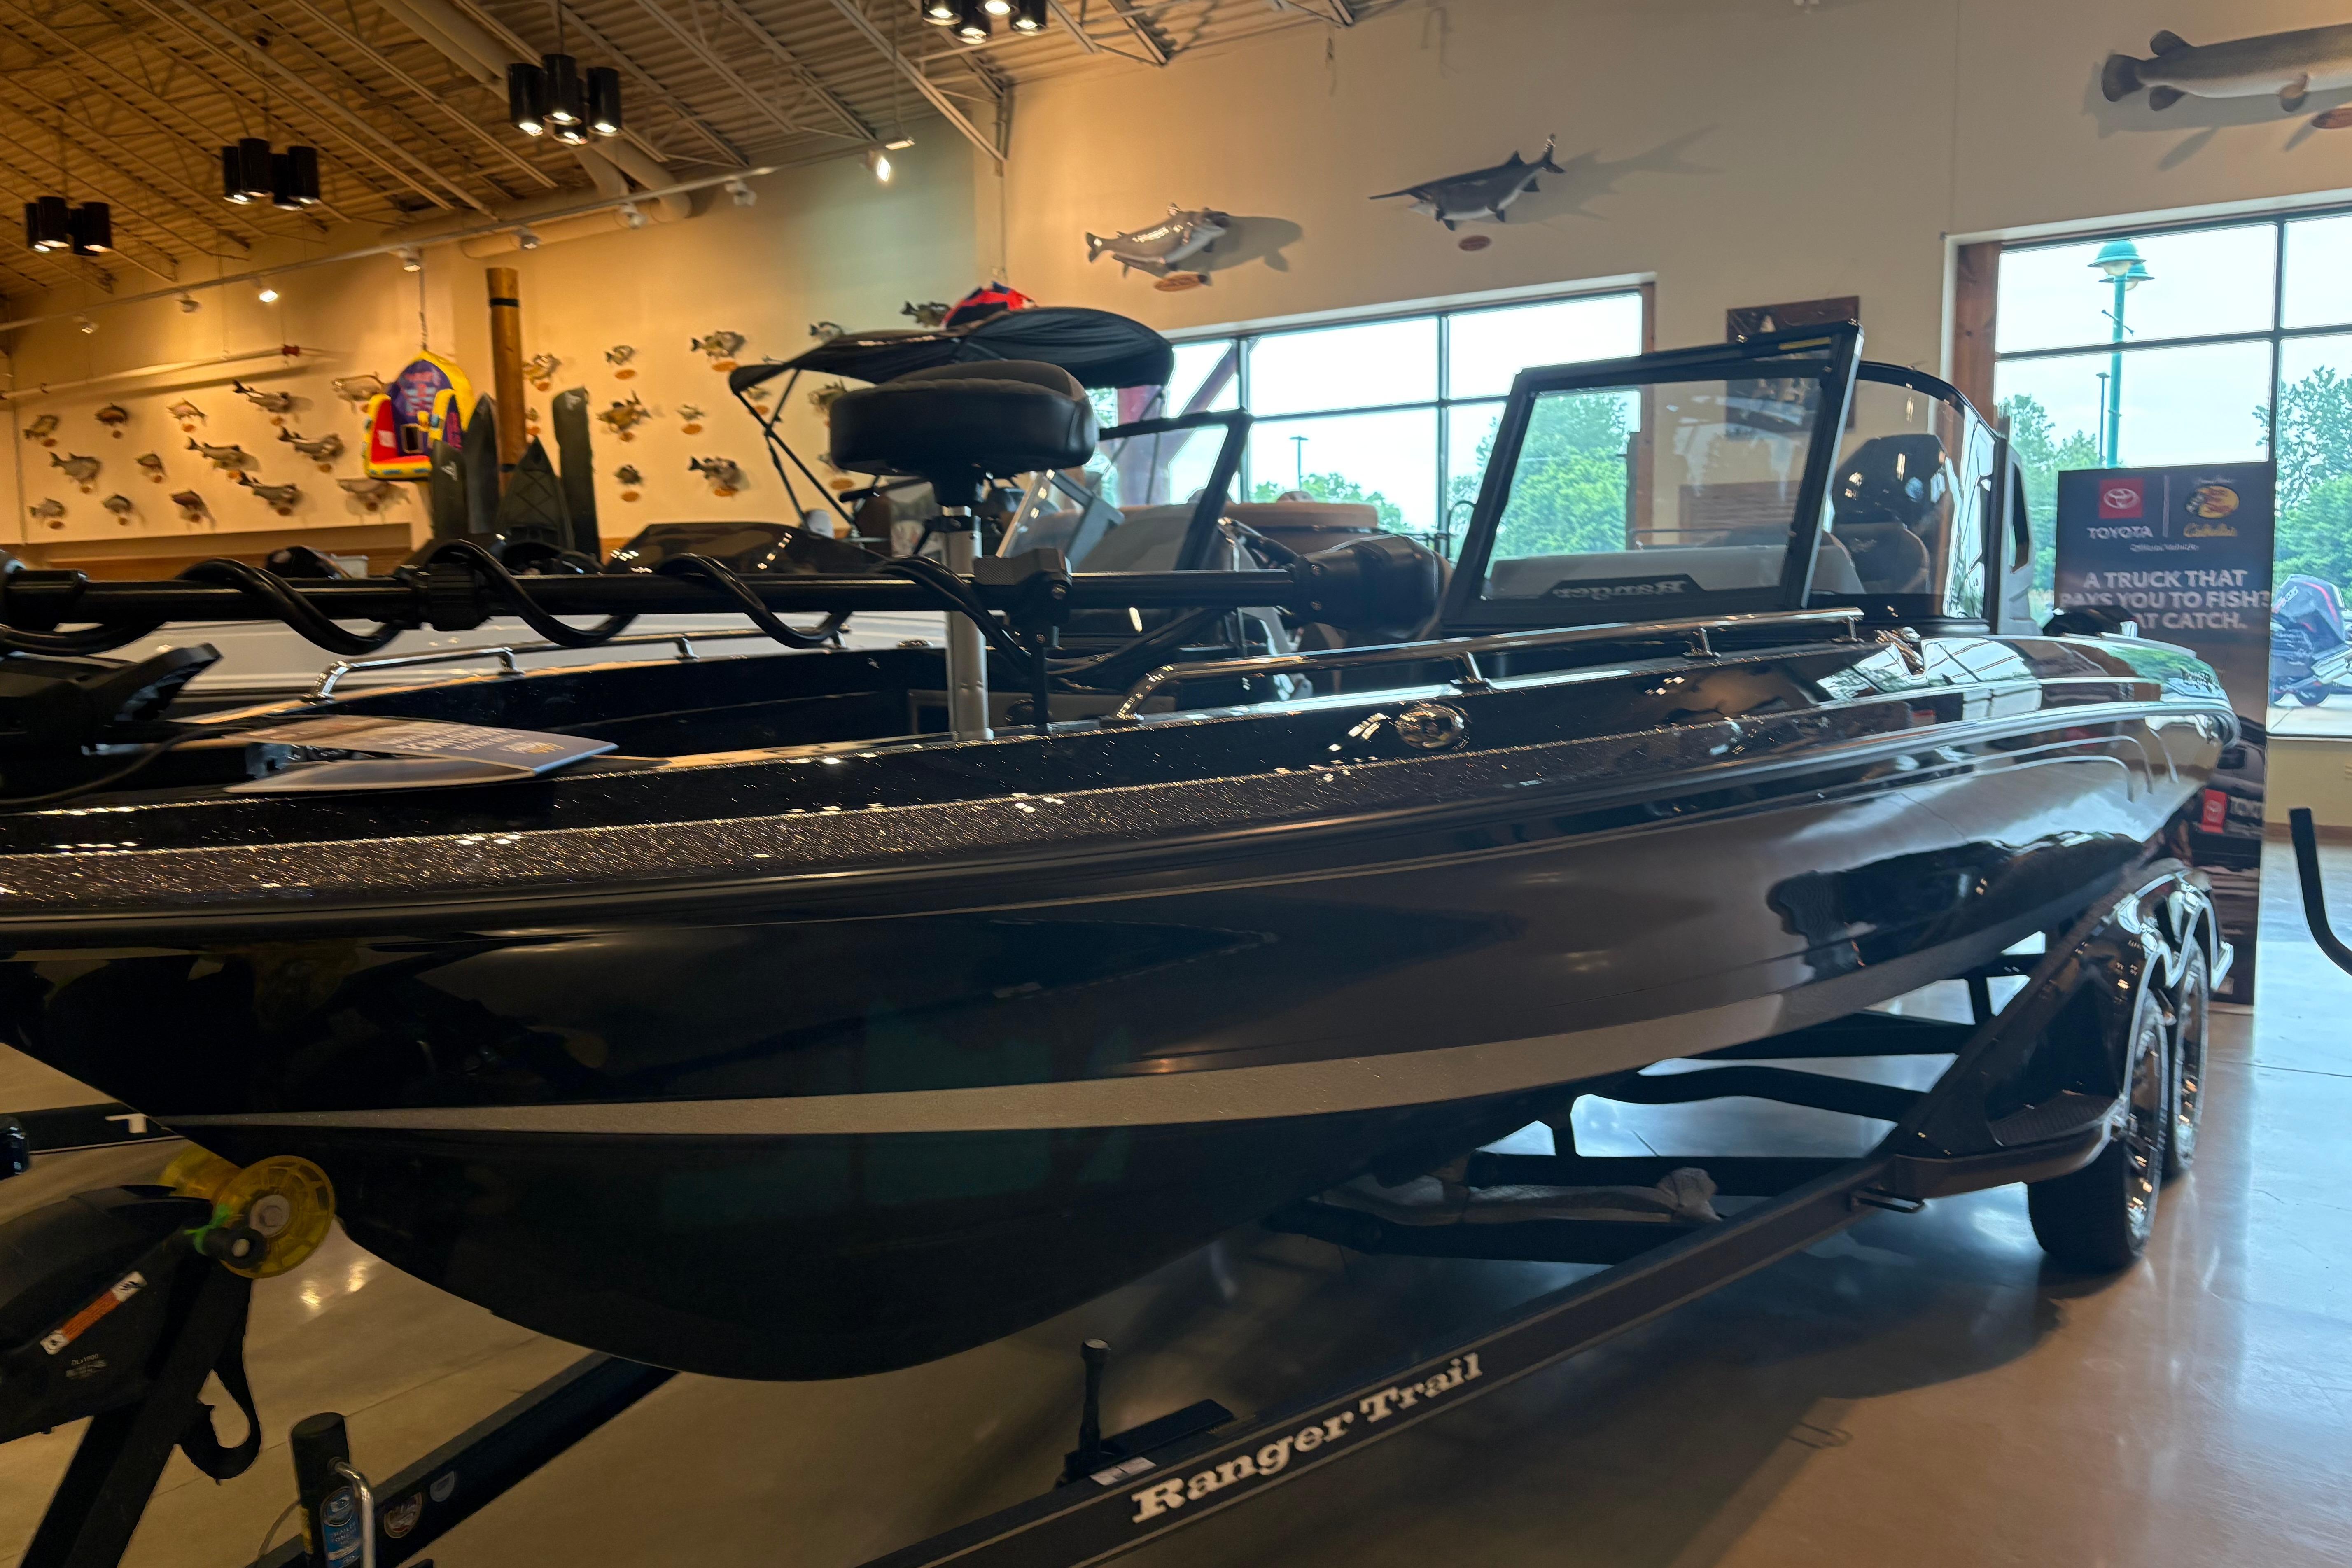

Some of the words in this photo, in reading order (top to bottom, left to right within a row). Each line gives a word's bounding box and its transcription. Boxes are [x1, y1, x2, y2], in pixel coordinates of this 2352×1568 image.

[2086, 525, 2154, 539] TOYOTA
[2083, 572, 2100, 588] A
[2103, 570, 2182, 588] TRUCK
[2184, 569, 2247, 588] THAT
[2060, 593, 2113, 607] PAYS
[2116, 592, 2166, 608] YOU
[2169, 591, 2203, 608] TO
[2162, 612, 2248, 629] CATCH.
[1131, 1411, 1355, 1523] Ranger
[1359, 1352, 1483, 1423] Trail
